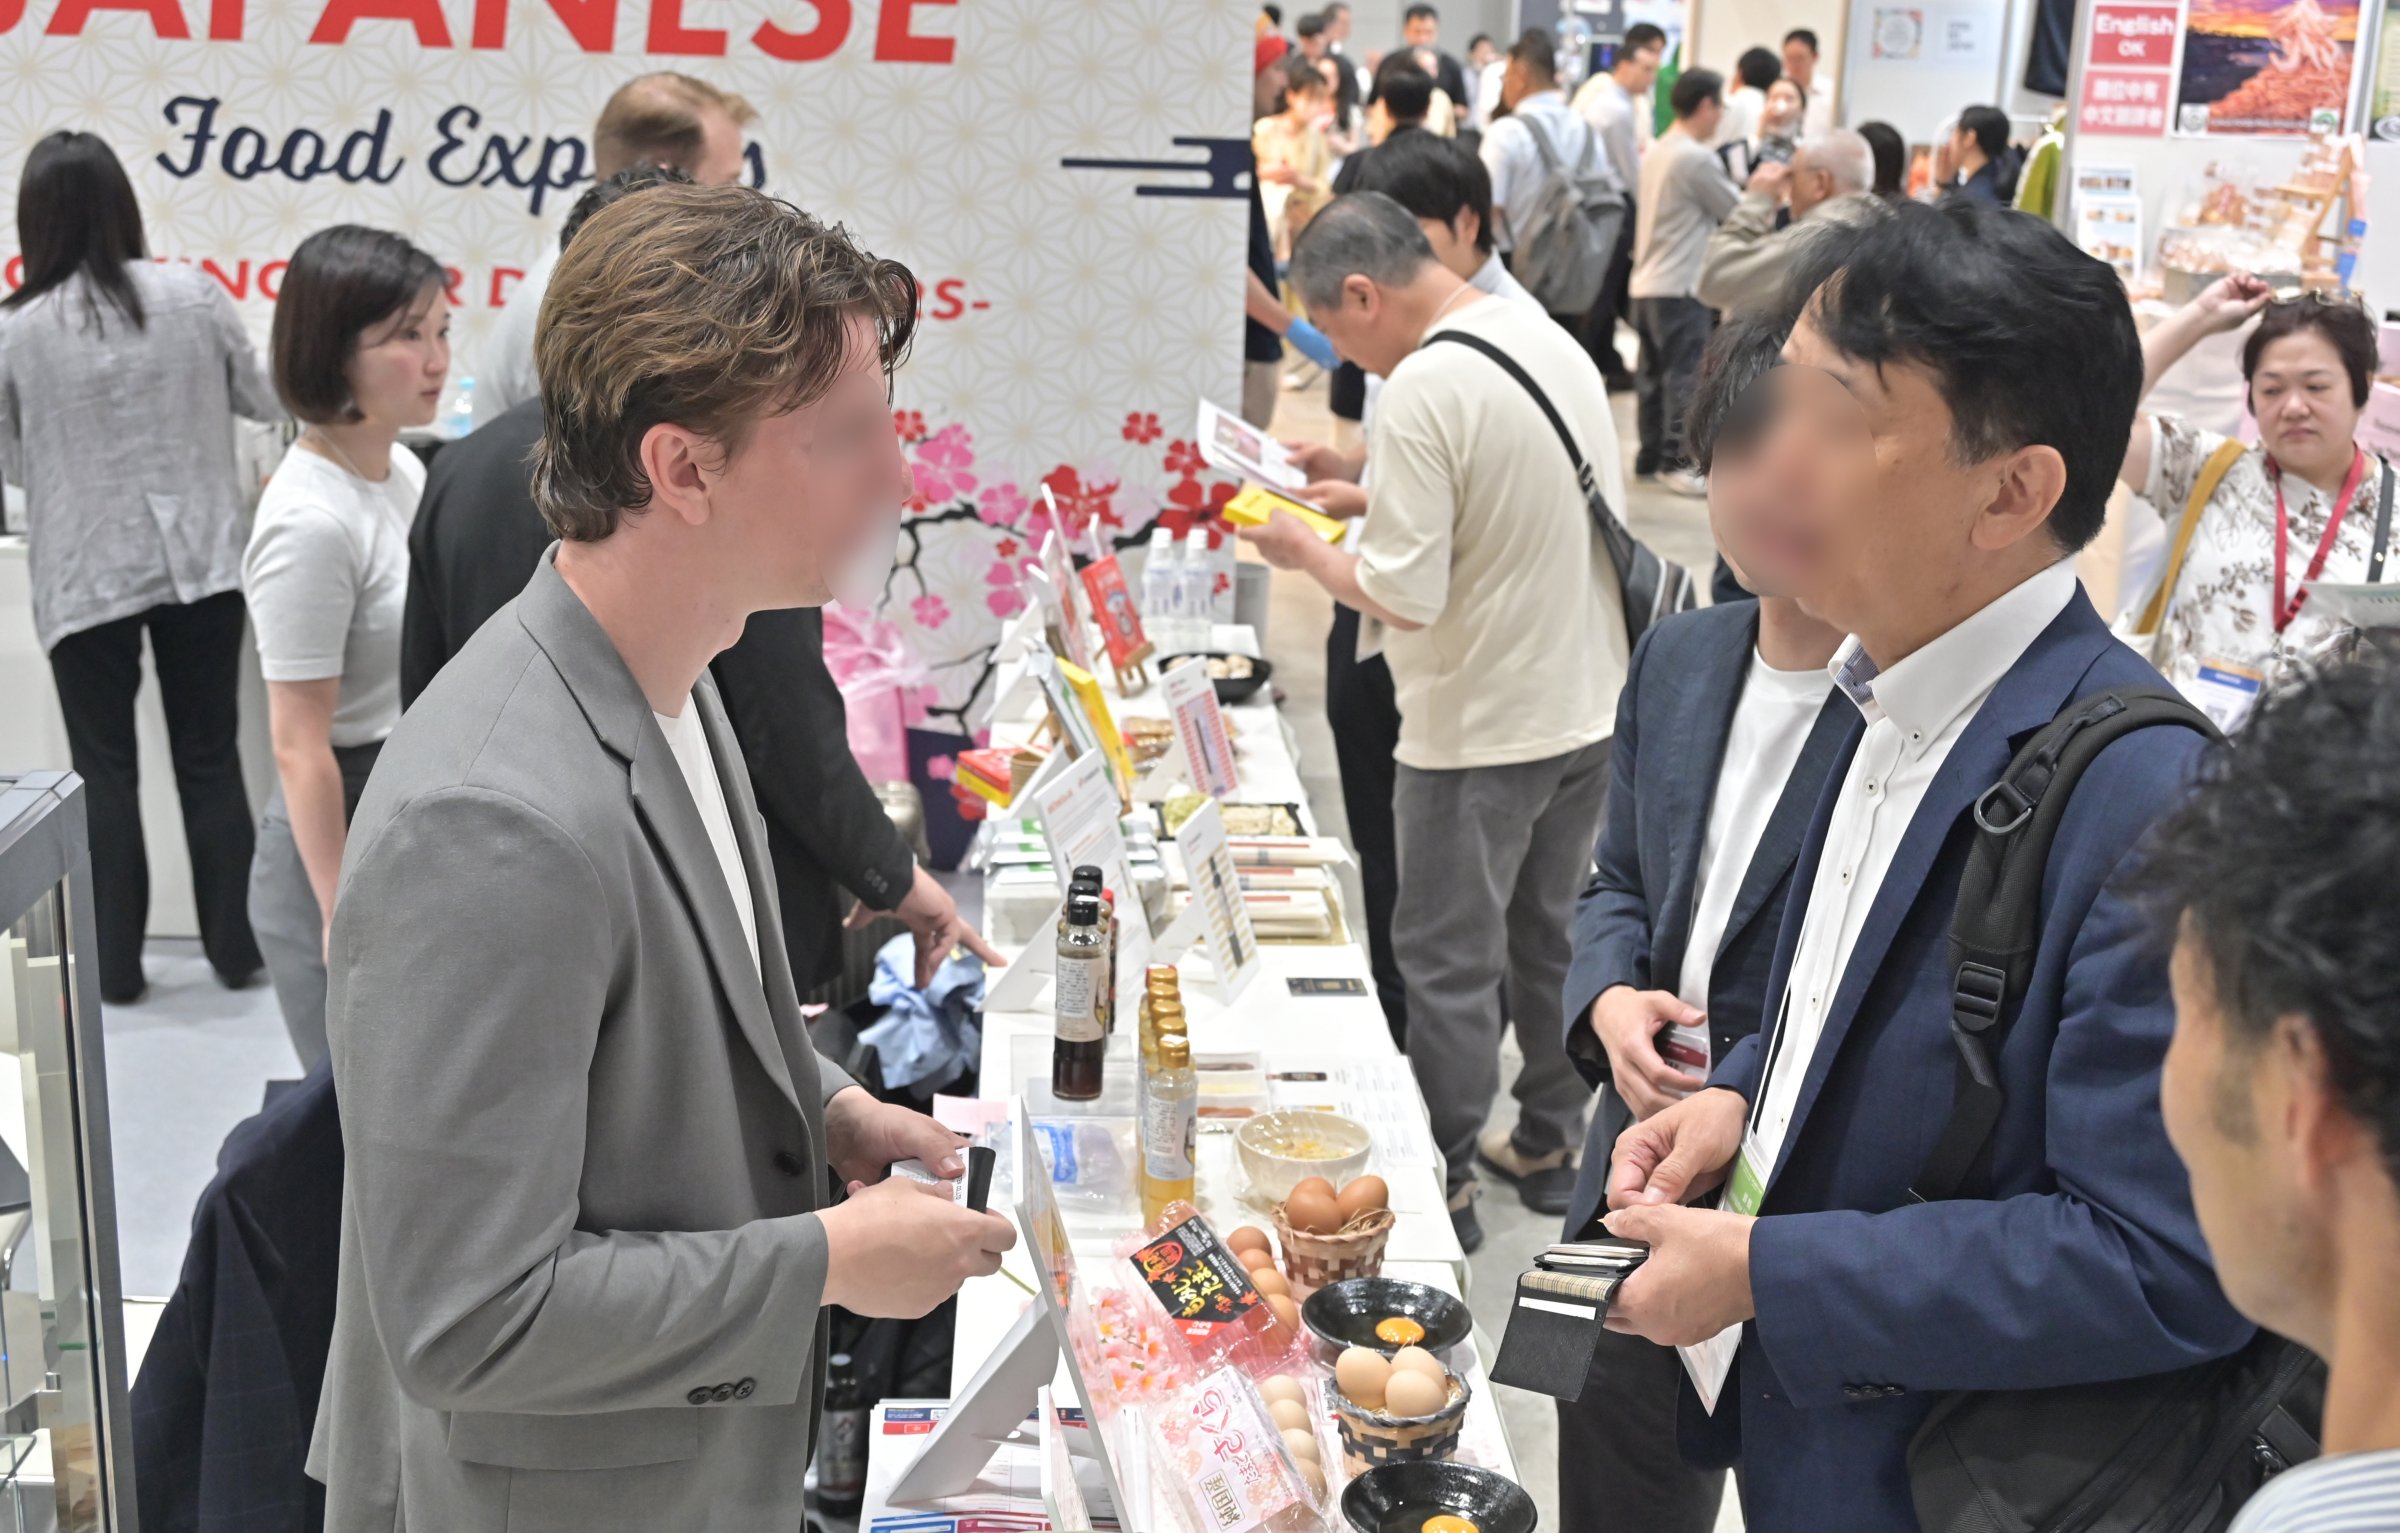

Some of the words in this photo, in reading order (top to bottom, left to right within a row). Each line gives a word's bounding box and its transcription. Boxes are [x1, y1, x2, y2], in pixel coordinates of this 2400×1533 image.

[2095, 13, 2175, 38] English
[2118, 40, 2146, 57] OK
[156, 95, 404, 187] Food
[428, 104, 767, 216] Exps
[1172, 1278, 1206, 1318] もみじ
[1183, 1259, 1224, 1299] たまご
[1193, 1388, 1244, 1463] さくら
[1204, 1473, 1242, 1526] 純国産
